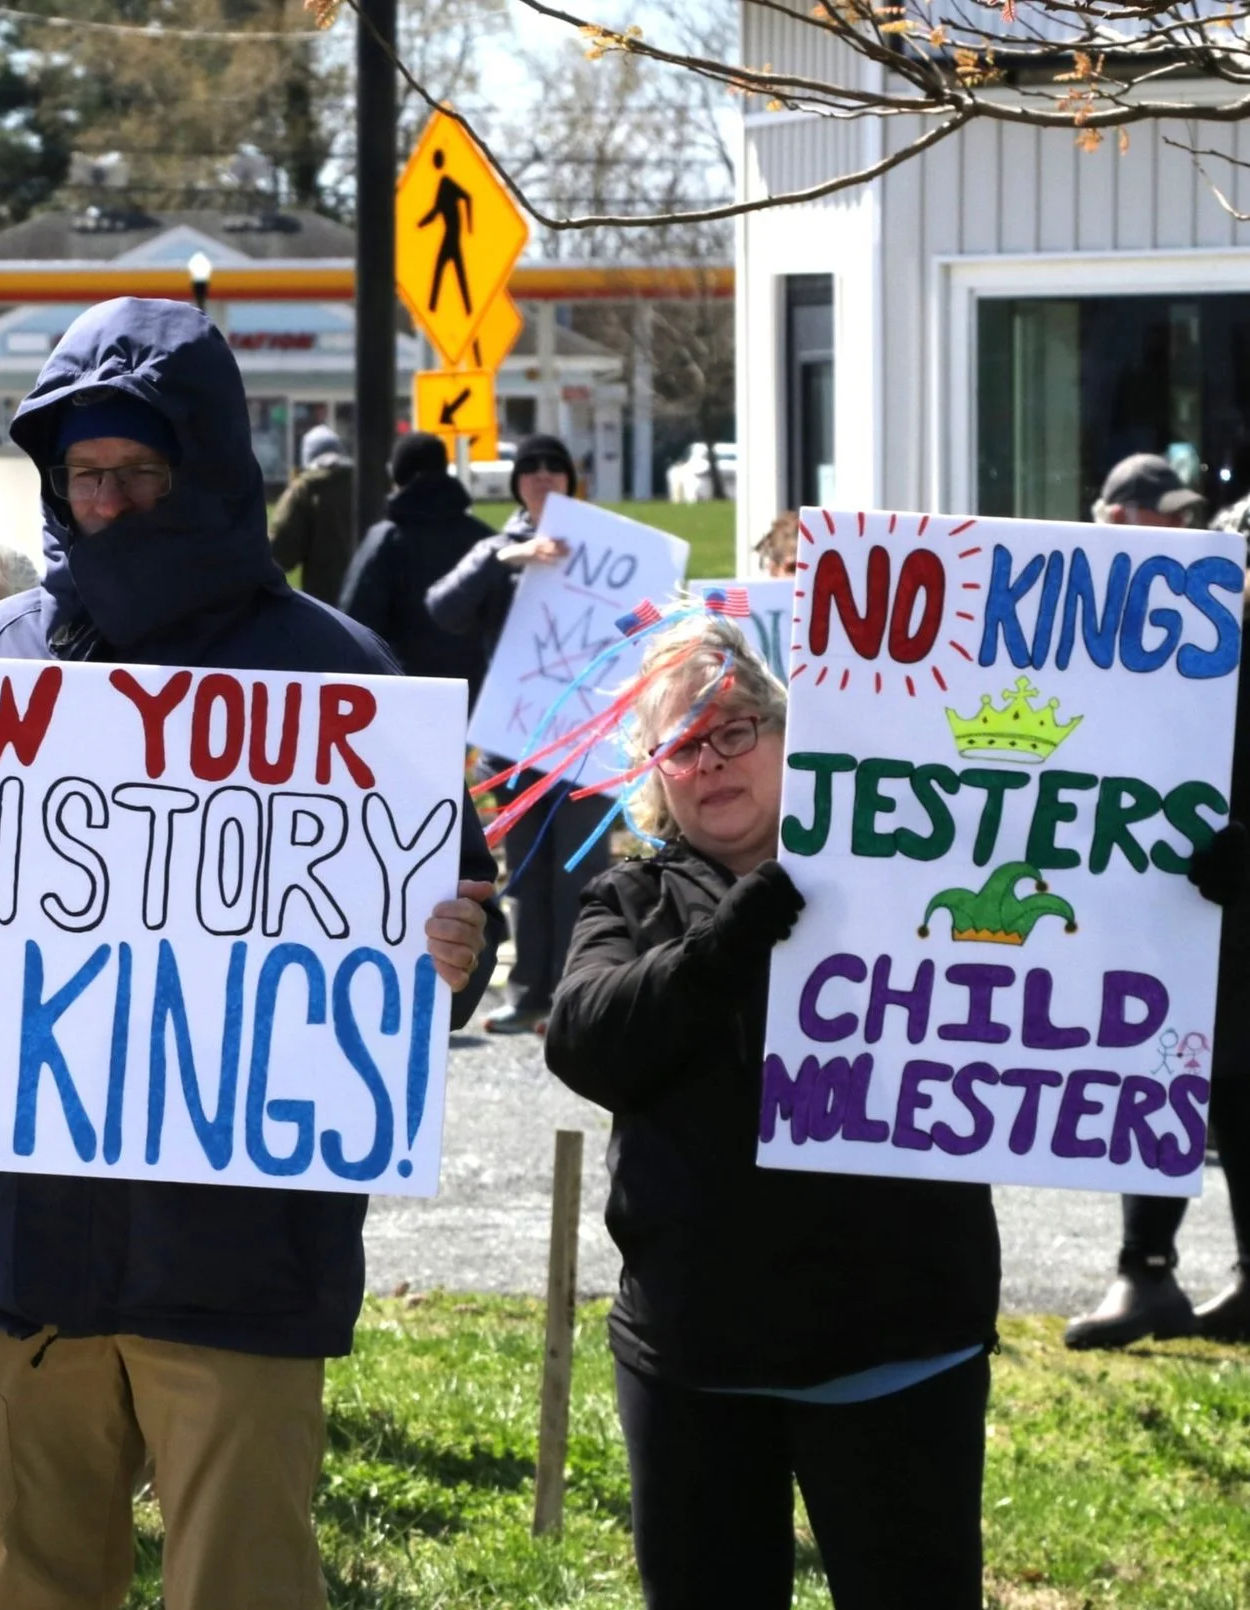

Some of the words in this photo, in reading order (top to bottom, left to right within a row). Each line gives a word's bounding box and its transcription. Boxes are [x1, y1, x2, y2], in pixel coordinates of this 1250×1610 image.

[565, 542, 638, 590] NO
[809, 545, 946, 664] NO
[978, 544, 1246, 680] KINGS
[109, 670, 377, 789] YOUR
[781, 752, 1230, 876] JESTERS
[12, 938, 438, 1182] KINGS!
[798, 953, 1170, 1050] CHILD
[759, 1052, 1211, 1177] MOLESTERS
